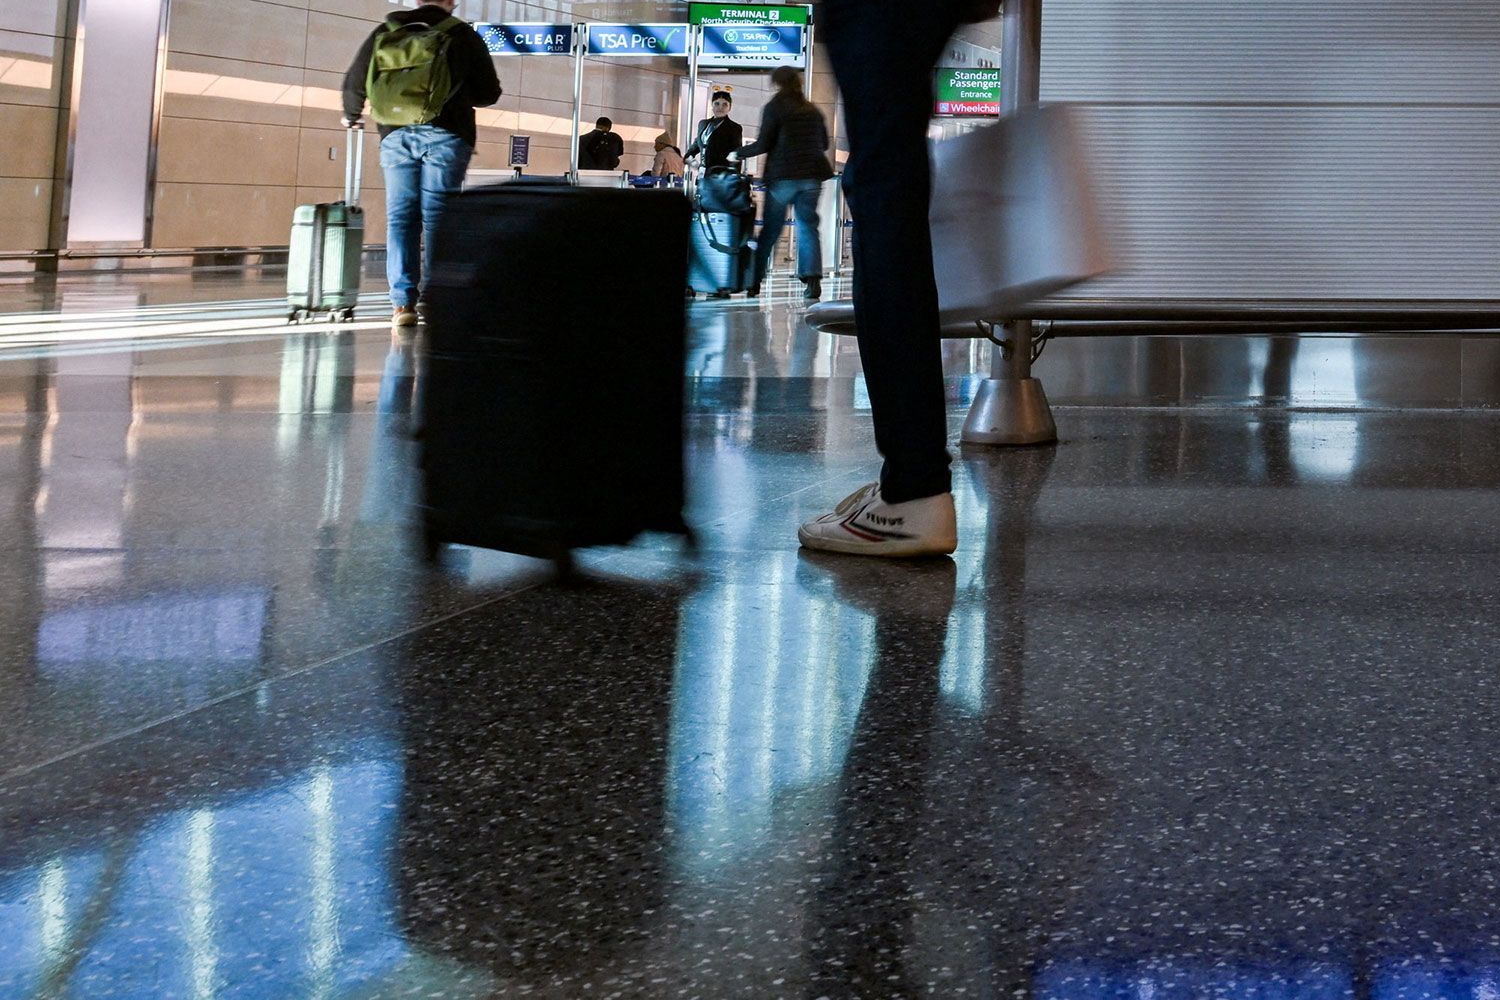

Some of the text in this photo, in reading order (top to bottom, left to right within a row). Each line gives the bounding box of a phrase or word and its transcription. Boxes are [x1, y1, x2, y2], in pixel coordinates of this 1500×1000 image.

[720, 9, 767, 19] TERMINAL
[514, 33, 564, 45] CLEAR
[598, 33, 657, 49] TSA Pre
[742, 33, 755, 41] TSA
[954, 71, 998, 80] Standard
[960, 90, 992, 98] Entrance
